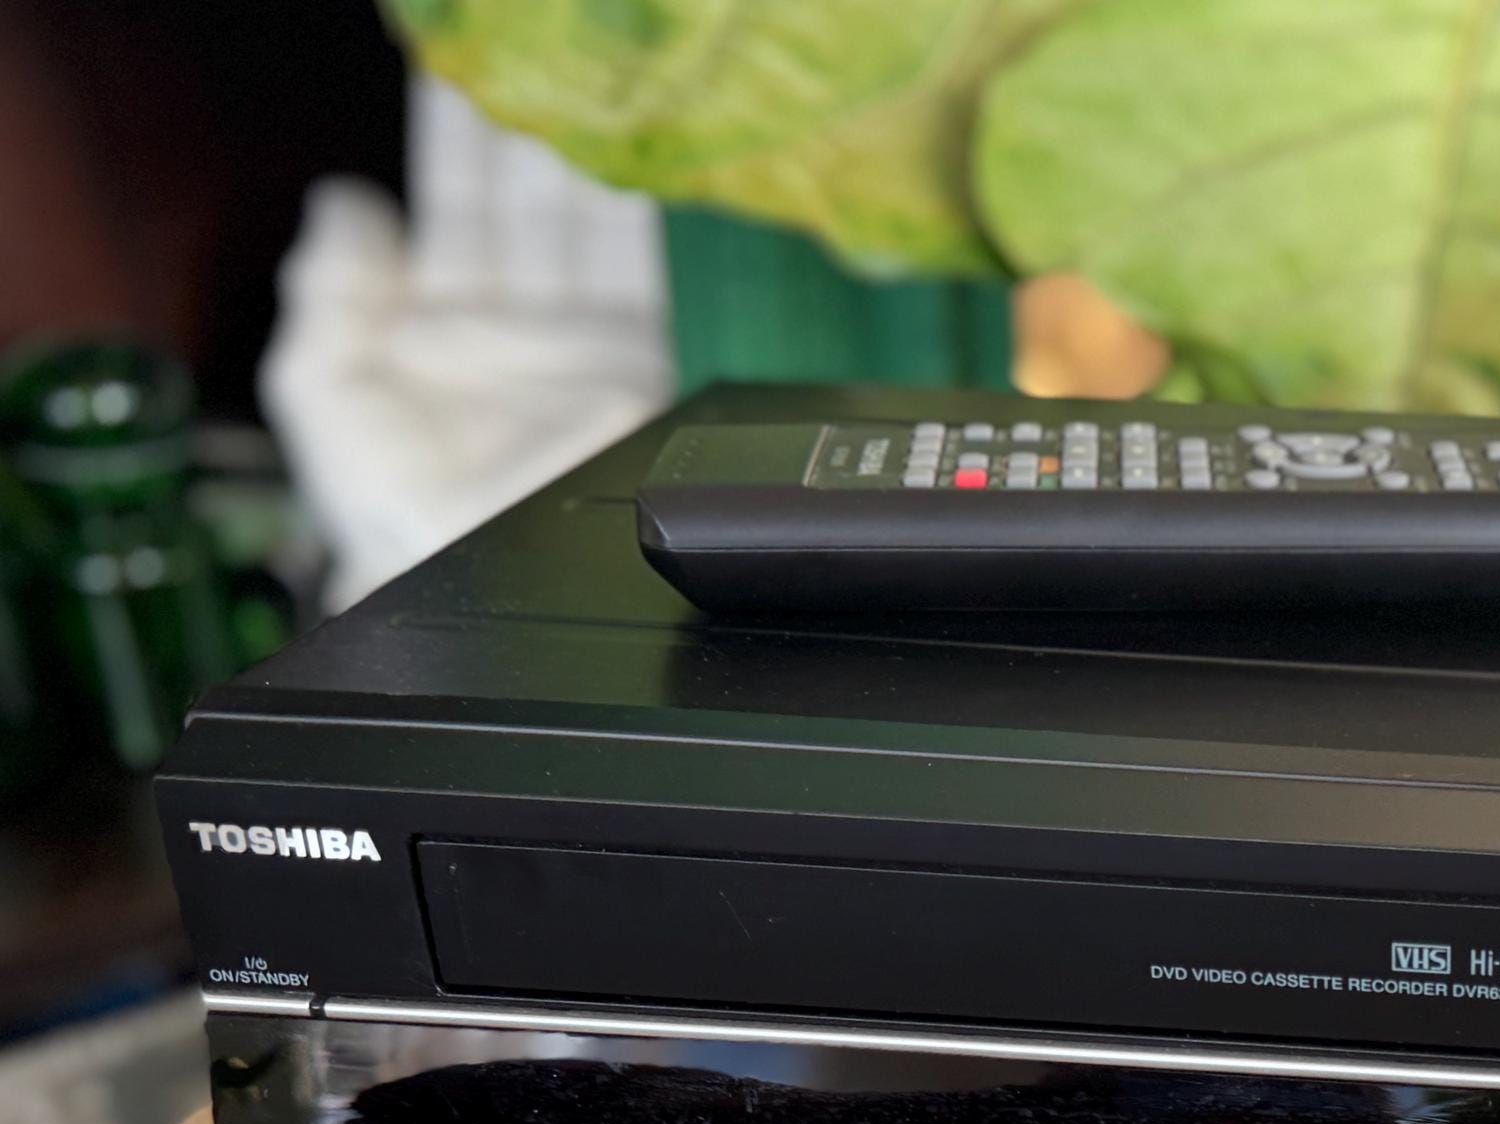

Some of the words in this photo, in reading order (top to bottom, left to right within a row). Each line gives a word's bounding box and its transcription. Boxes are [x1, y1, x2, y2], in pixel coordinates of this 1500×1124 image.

[189, 821, 382, 862] TOSHIBA
[1396, 947, 1447, 970] VHS
[209, 969, 309, 987] ON/STANDBY
[1150, 965, 1187, 981] DVD
[1191, 968, 1247, 985] VIDEO
[1250, 972, 1343, 991] CASSETTE
[1348, 977, 1448, 997] RECORDER
